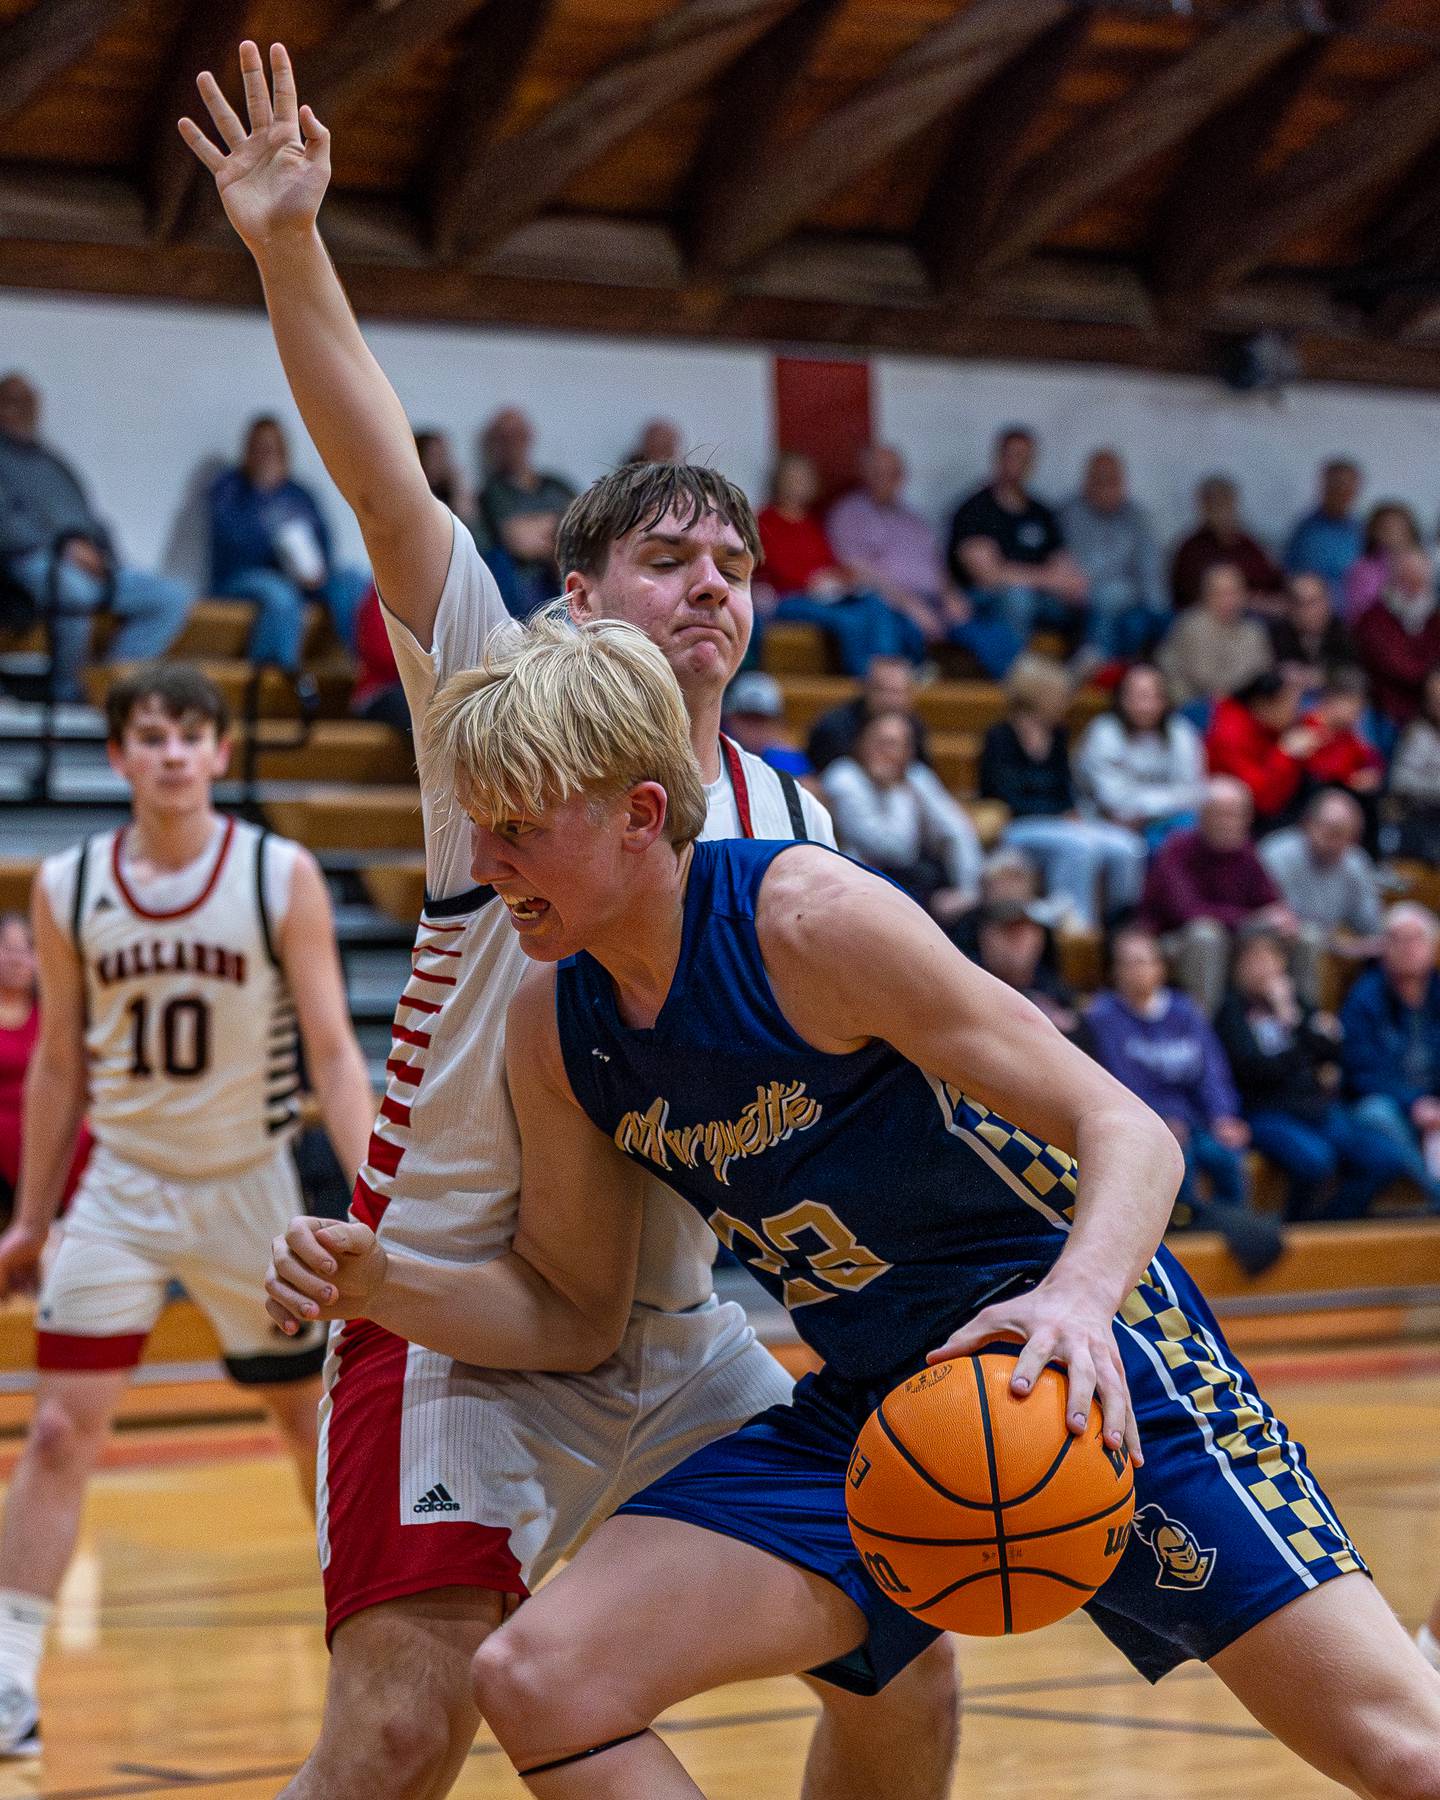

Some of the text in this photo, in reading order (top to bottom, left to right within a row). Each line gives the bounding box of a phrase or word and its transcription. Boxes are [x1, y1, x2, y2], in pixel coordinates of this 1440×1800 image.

[127, 992, 209, 1079] 10
[707, 1199, 894, 1311] 23
[413, 1500, 461, 1513] adidas
